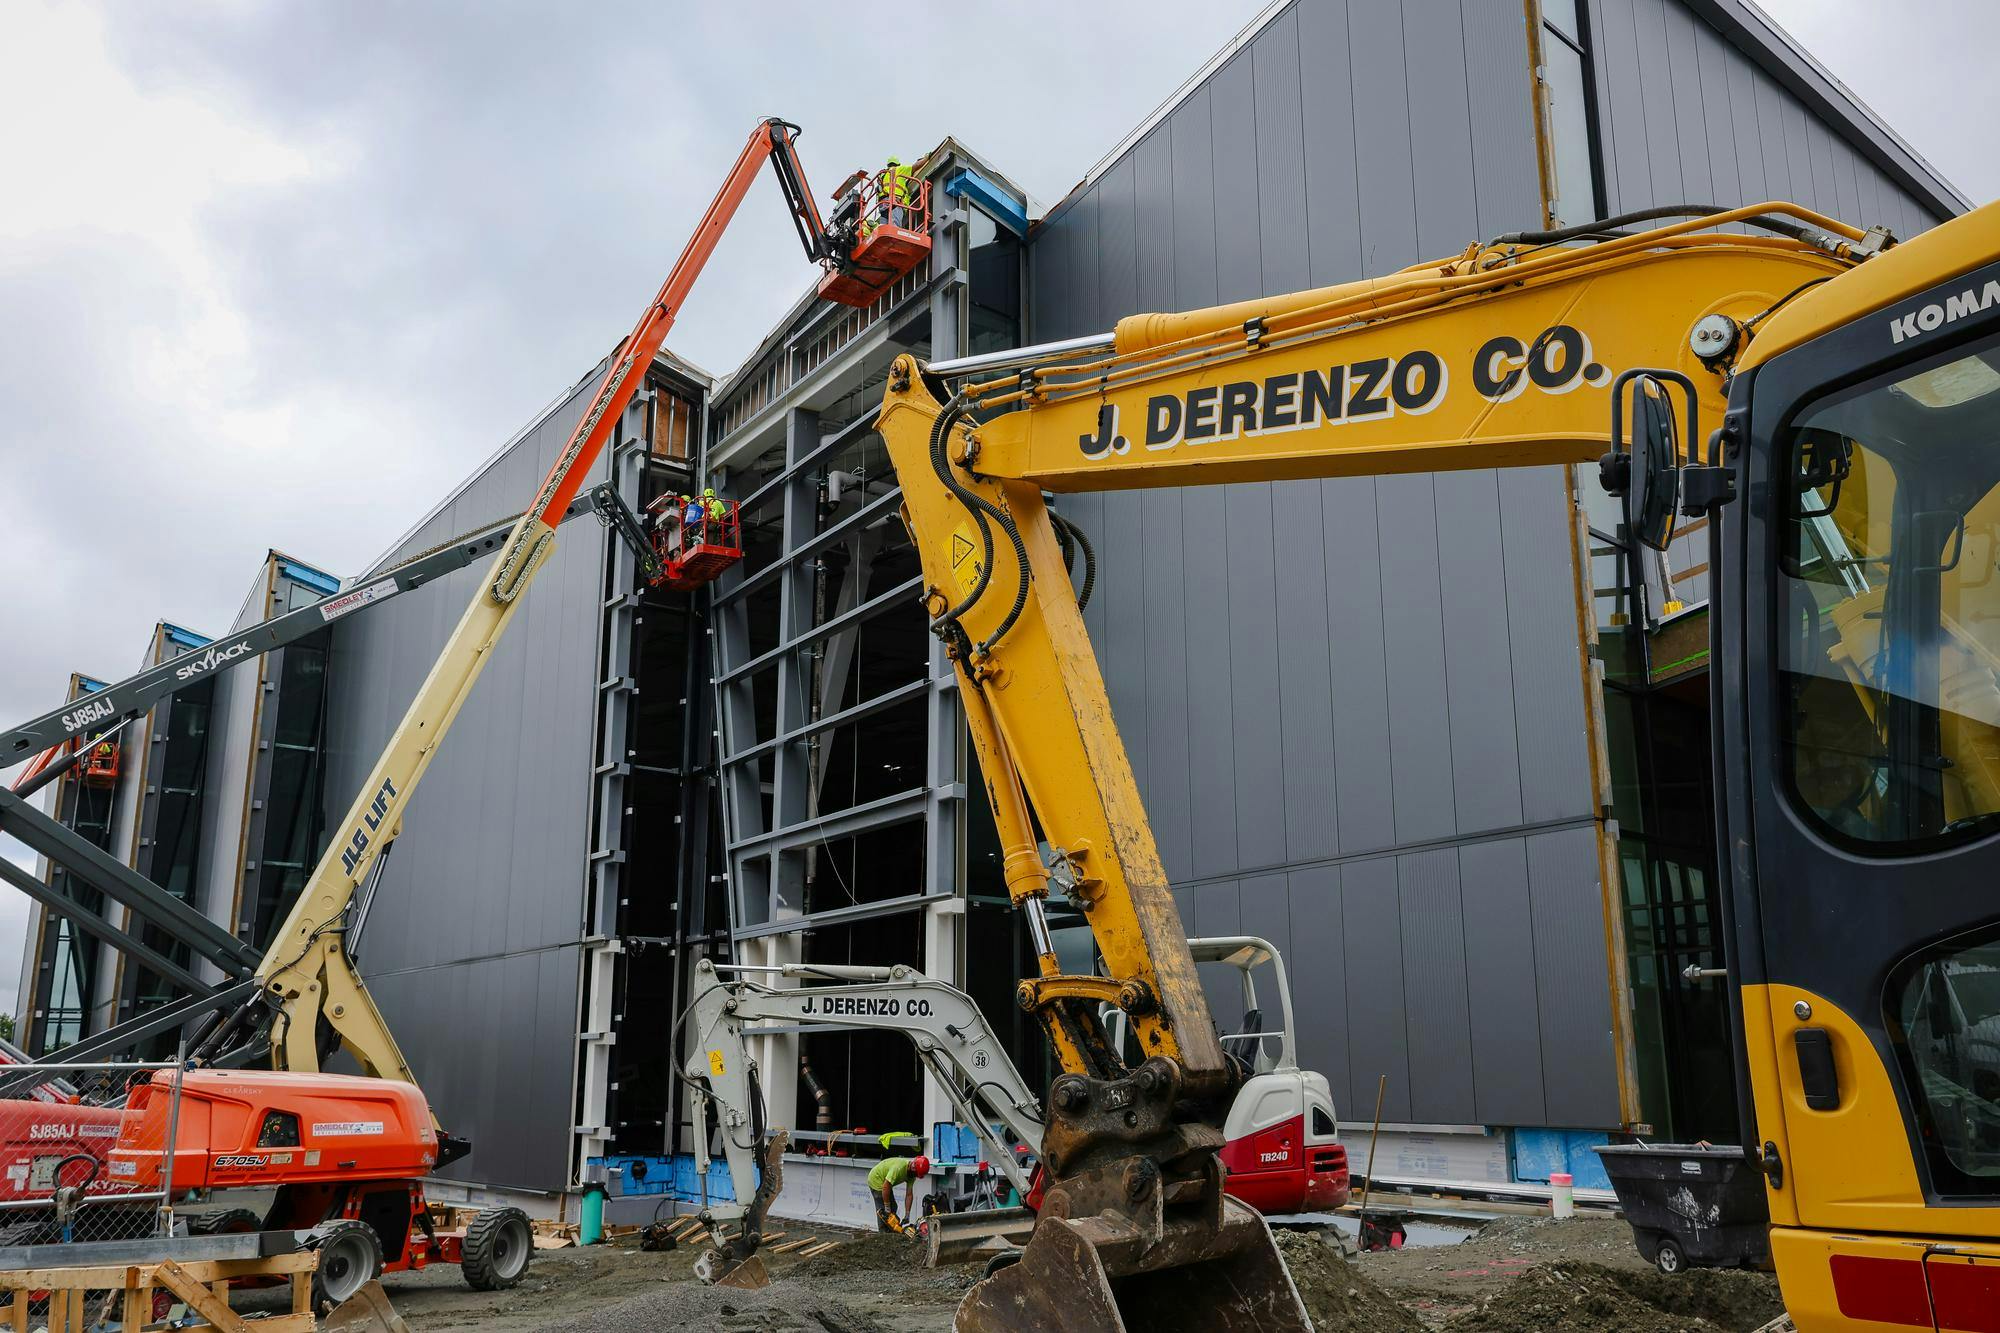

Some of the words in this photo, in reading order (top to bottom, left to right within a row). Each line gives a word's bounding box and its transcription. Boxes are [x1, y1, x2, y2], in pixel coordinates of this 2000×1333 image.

[1079, 403, 1130, 459] J.
[1145, 350, 1448, 449] DERENZO
[1473, 325, 1612, 403] CO.
[323, 591, 364, 613] SMEDLEY
[175, 641, 252, 680] SKYJACK
[61, 697, 115, 732] SJ85AJ
[341, 828, 370, 877] JLG
[363, 776, 397, 832] LIFT
[801, 997, 817, 1014] J.
[823, 997, 901, 1016] DERENZO
[906, 999, 934, 1017] CO.
[975, 1055, 986, 1067] 38
[30, 1124, 75, 1139] SJ85AJ
[214, 1155, 270, 1167] 670SJ
[1260, 1151, 1288, 1163] TB240
